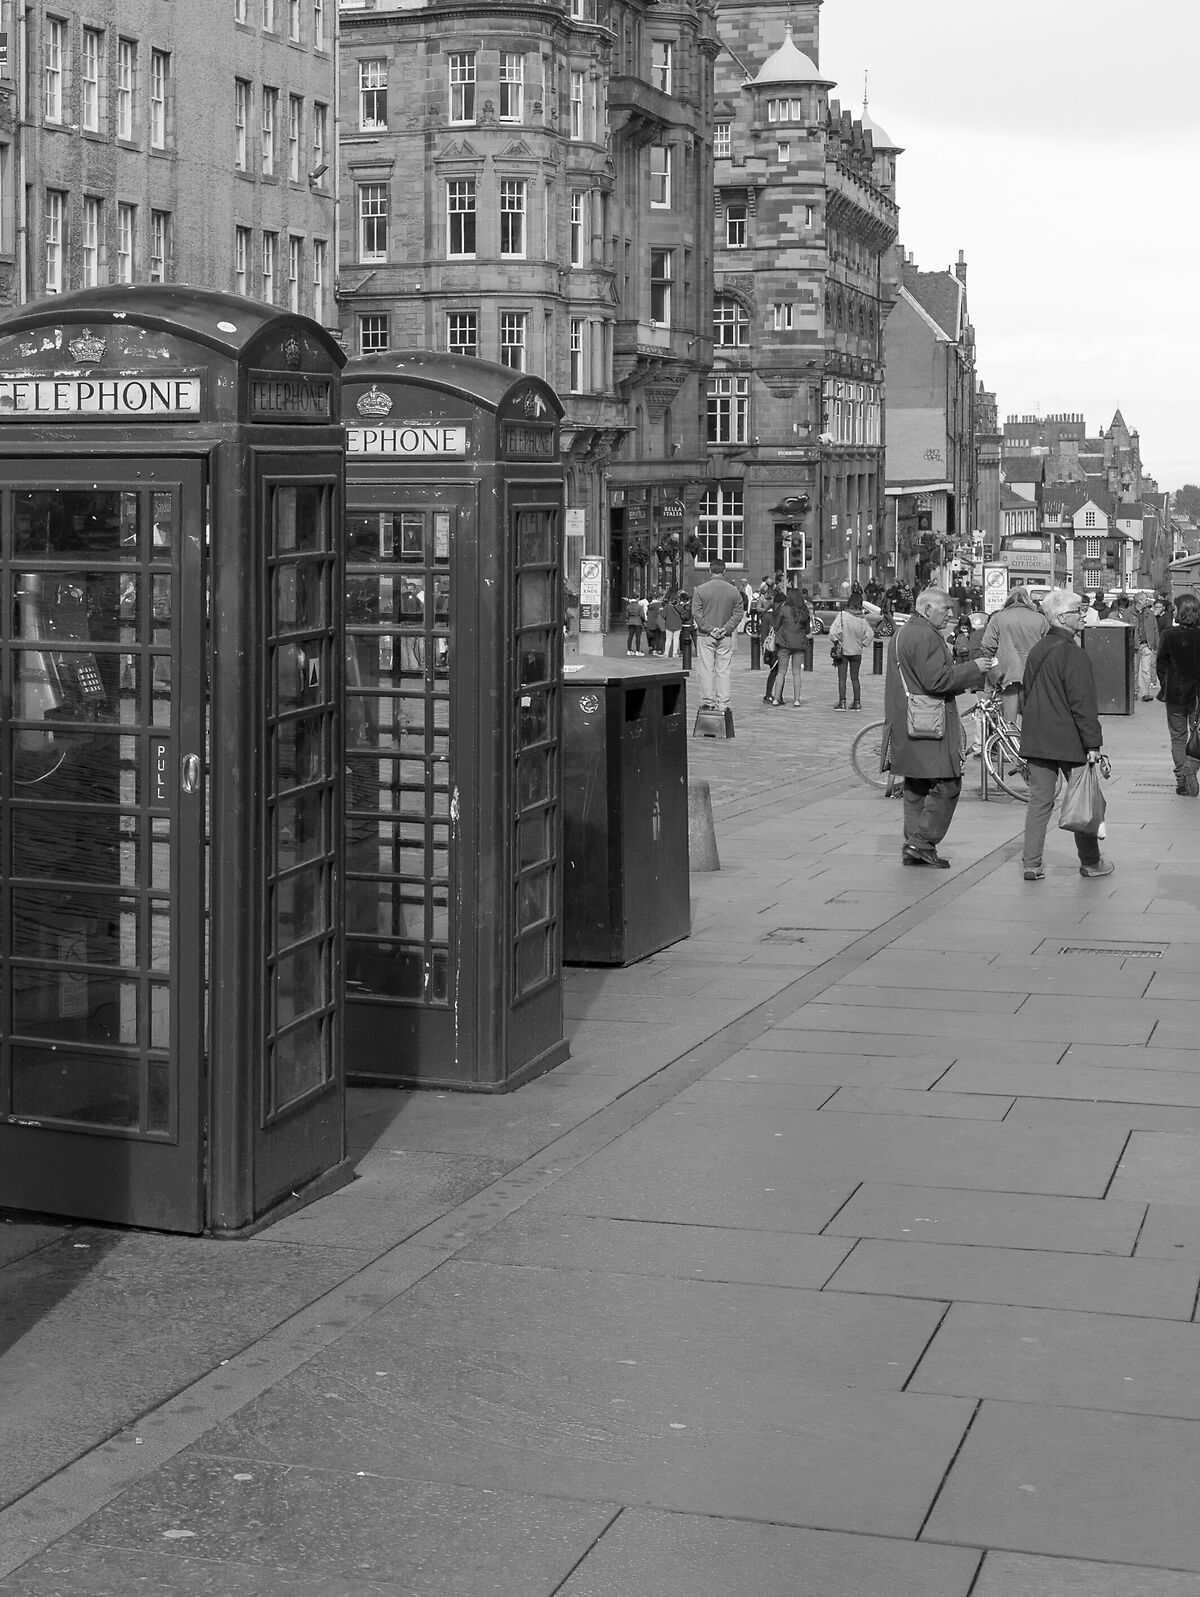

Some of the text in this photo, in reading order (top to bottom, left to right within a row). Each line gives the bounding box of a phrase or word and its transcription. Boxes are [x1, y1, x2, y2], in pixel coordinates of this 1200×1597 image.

[250, 382, 324, 413] TELEPHONE
[345, 428, 457, 453] EPHONE
[504, 430, 550, 453] TELEPHONE
[157, 745, 166, 799] PULL
